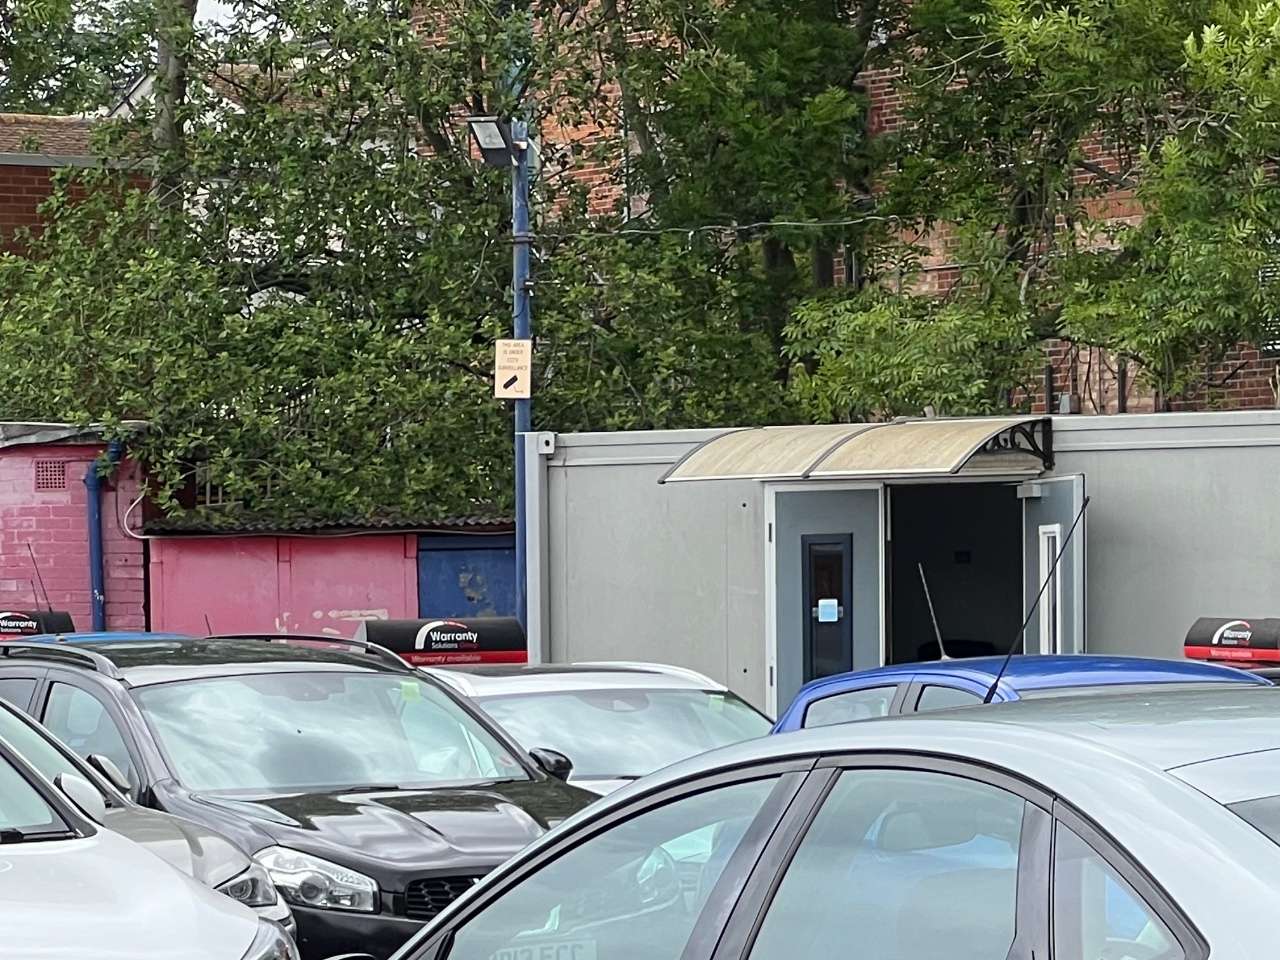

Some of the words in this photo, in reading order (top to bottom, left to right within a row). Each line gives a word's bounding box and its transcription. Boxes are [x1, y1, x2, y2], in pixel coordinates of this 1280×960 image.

[0, 619, 37, 630] Warranty
[430, 631, 478, 643] Warranty
[1224, 630, 1252, 640] Warranty
[411, 654, 446, 664] Warranty
